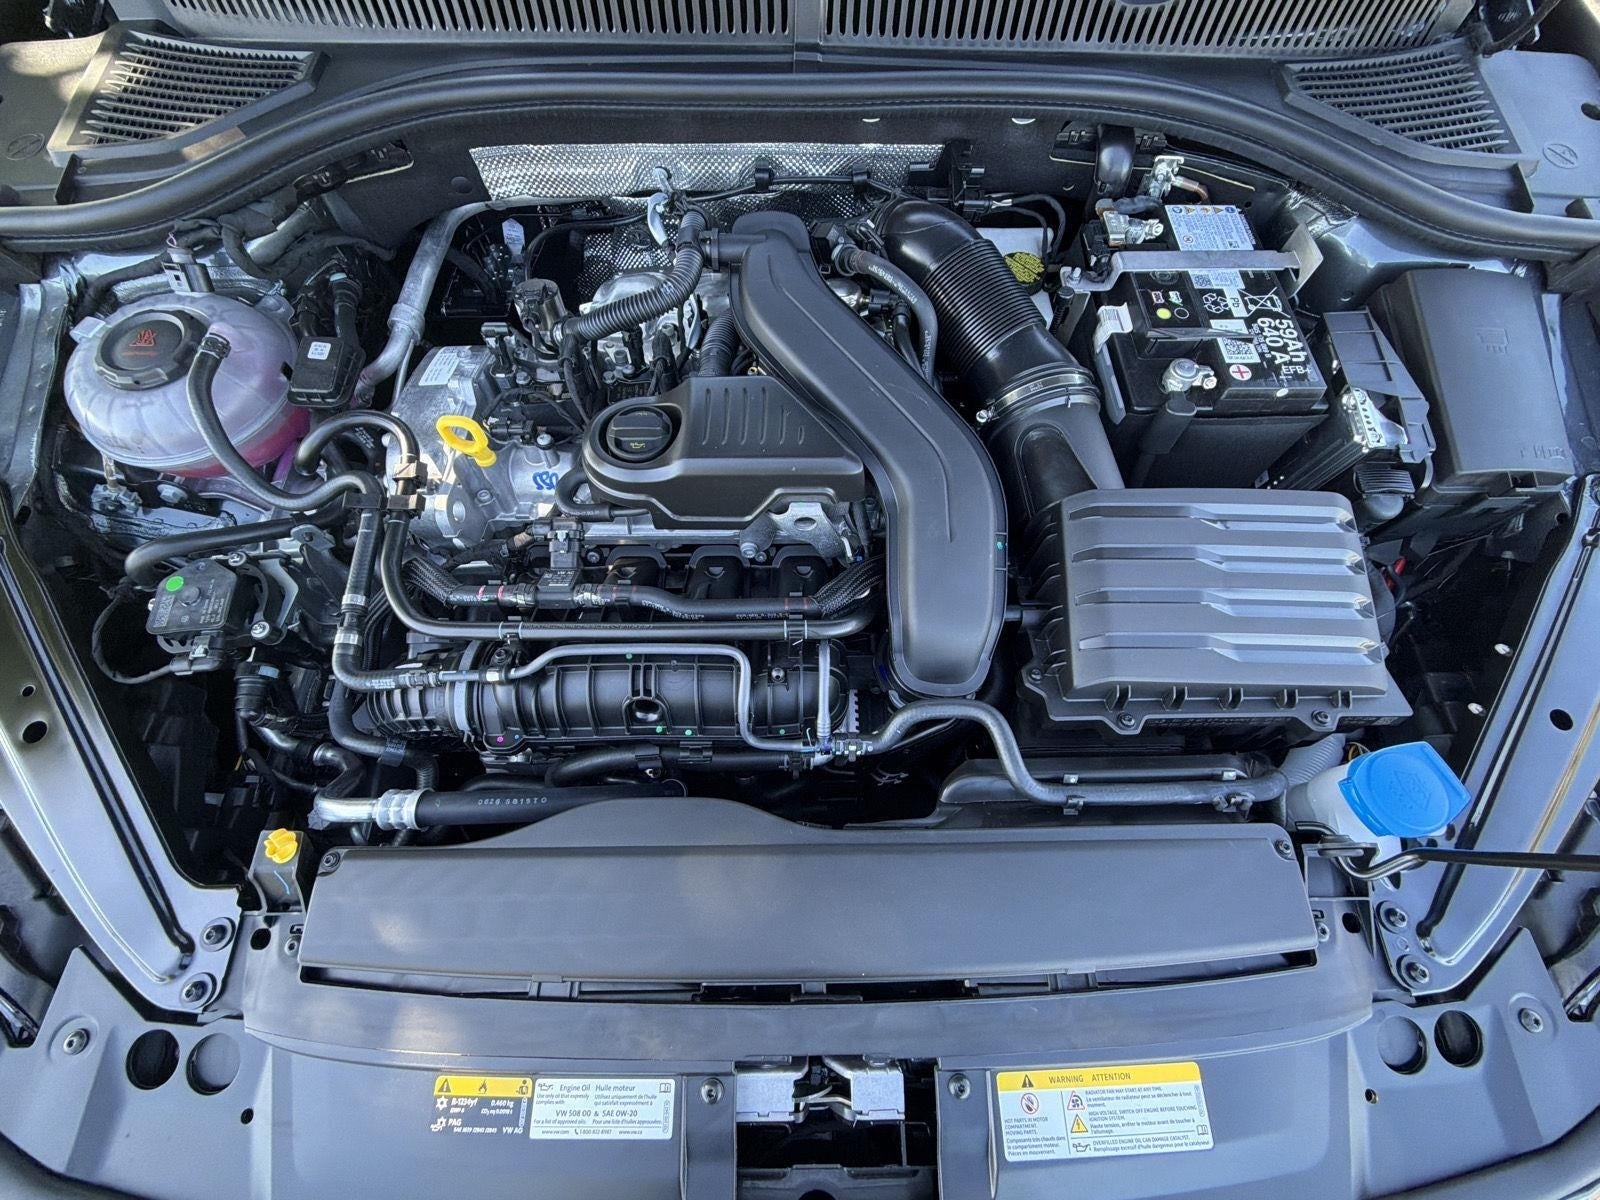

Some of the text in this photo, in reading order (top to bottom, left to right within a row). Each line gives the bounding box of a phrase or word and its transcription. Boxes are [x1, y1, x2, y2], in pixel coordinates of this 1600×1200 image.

[1257, 318, 1284, 346] 640
[1271, 351, 1291, 364] A
[1276, 319, 1307, 362] 59Ah
[1282, 366, 1311, 374] EFB+
[1049, 1073, 1131, 1084] WARNING ATTENTION
[560, 1084, 580, 1093] Engine
